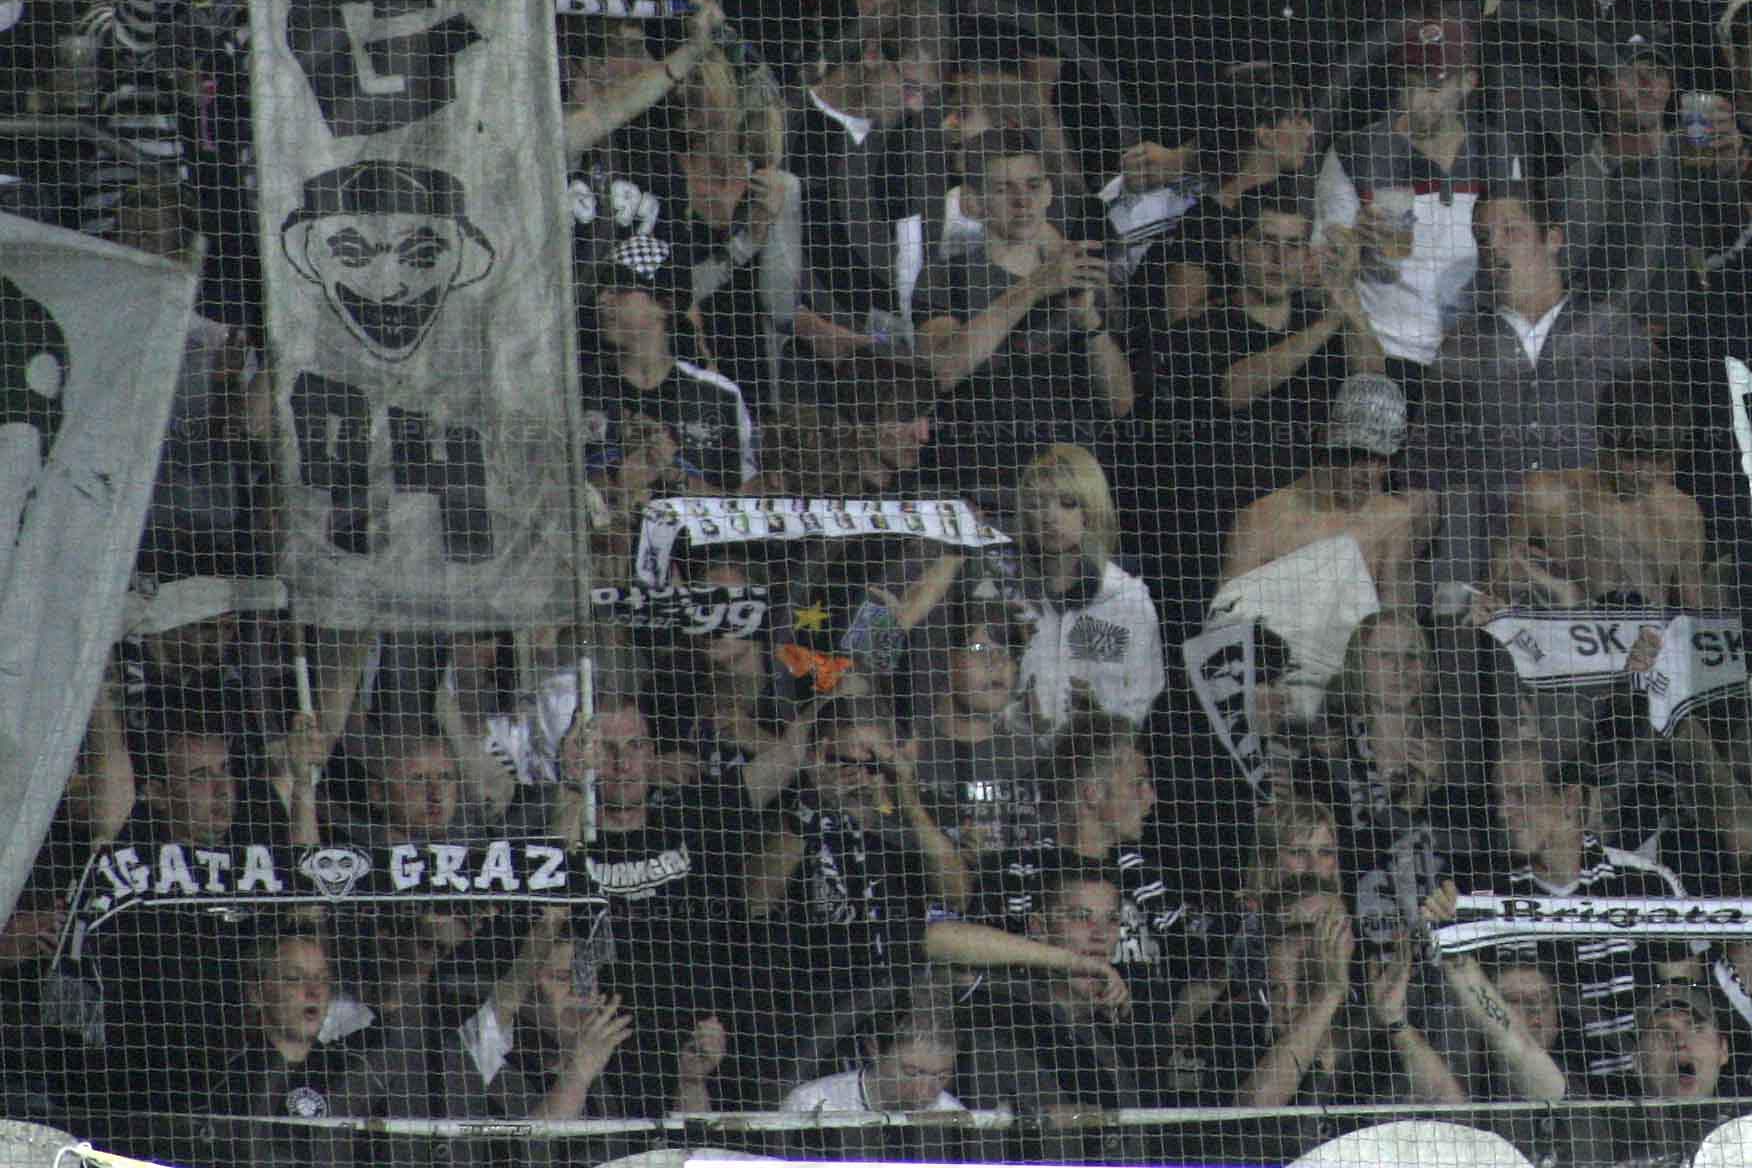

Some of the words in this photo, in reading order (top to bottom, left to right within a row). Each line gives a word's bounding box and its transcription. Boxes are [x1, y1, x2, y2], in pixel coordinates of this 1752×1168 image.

[1569, 623, 1628, 659] SK
[389, 840, 567, 892] GRAZ
[1499, 897, 1749, 929] Brigata
